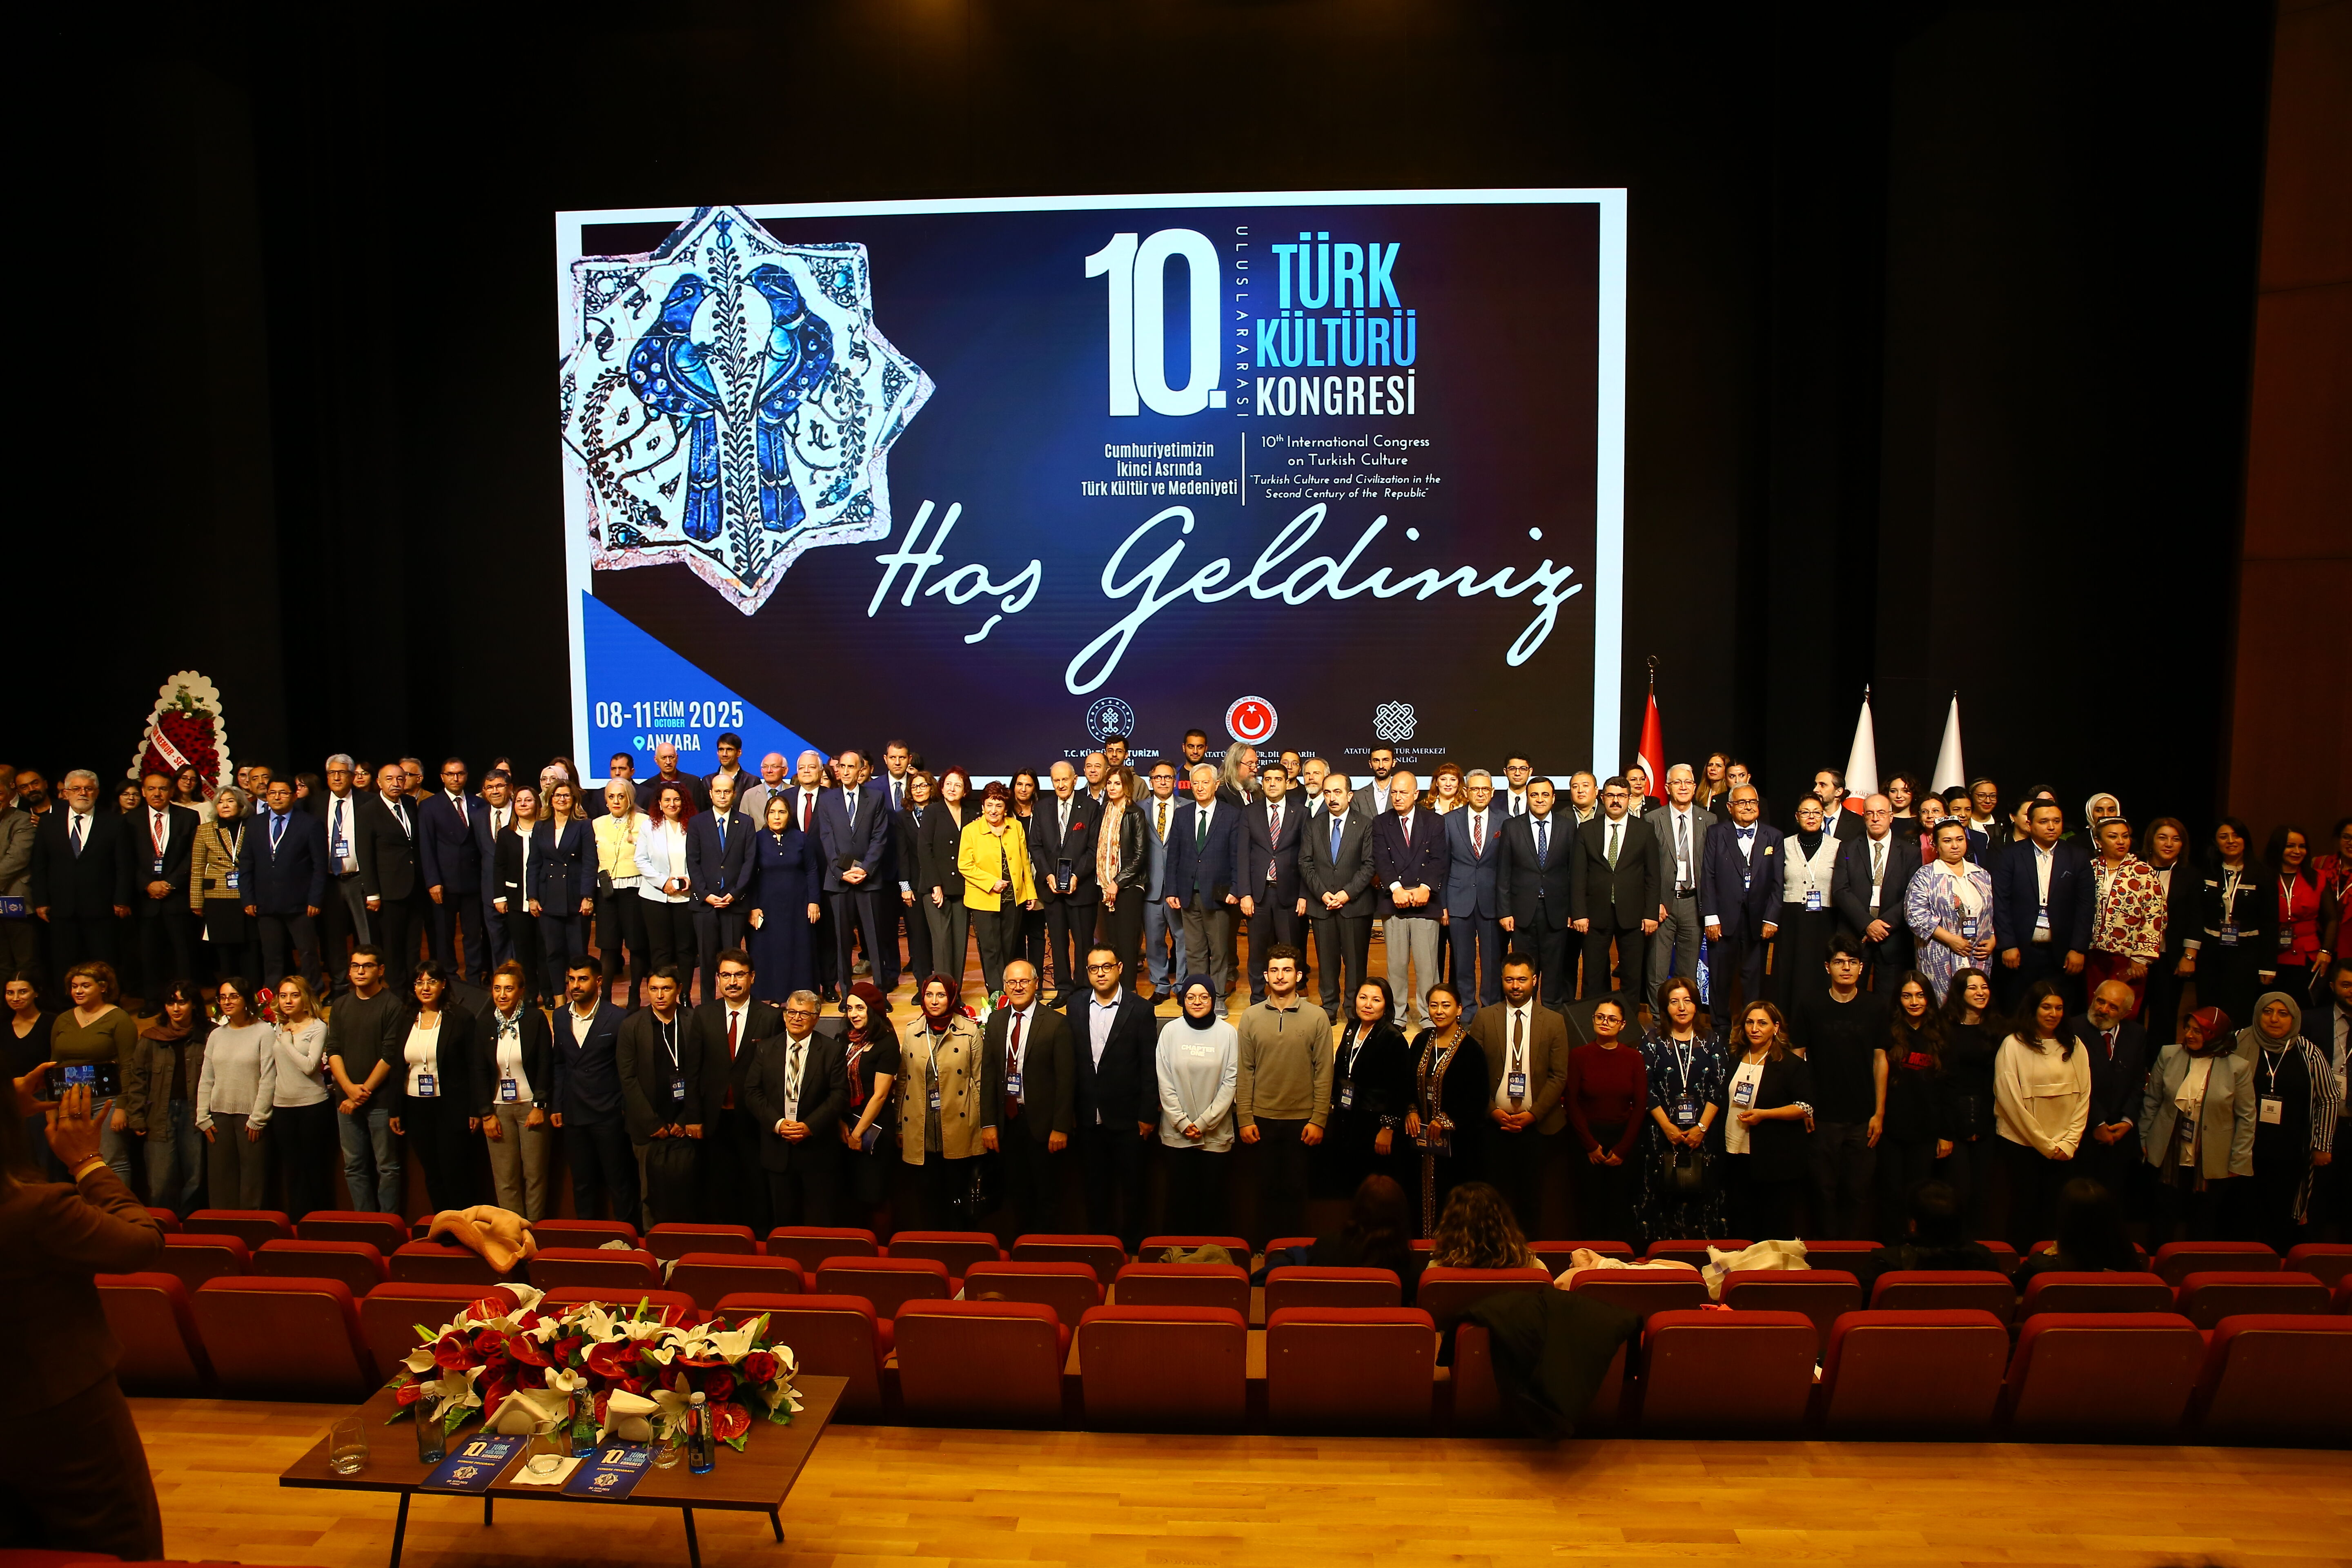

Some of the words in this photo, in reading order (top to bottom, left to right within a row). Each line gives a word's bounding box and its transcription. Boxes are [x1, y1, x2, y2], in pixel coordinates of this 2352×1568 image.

[1272, 231, 1401, 309] TÜRK
[1085, 228, 1227, 416] 10.
[1236, 226, 1250, 417] ULUSLARARASI
[1256, 309, 1417, 367] KÜLTÜRÜ
[1256, 368, 1415, 416] KONGRESİ
[1104, 441, 1214, 459] Cumhuriyetimizin
[1287, 434, 1368, 448] International
[1373, 434, 1430, 450] Congress
[1308, 452, 1356, 466] Turkish
[1361, 452, 1408, 466] Culture
[1117, 460, 1152, 477] İkinci
[1155, 461, 1202, 476] Asrında
[1294, 474, 1330, 484] Culture
[1333, 474, 1352, 484] and
[1356, 473, 1410, 484] Civilization
[1413, 475, 1422, 483] in
[1425, 473, 1441, 483] the
[1081, 481, 1108, 496] Türk
[1111, 480, 1149, 496] Kültür
[1151, 482, 1165, 495] ve
[1168, 479, 1238, 496] Medeniyeti
[1265, 488, 1302, 498] Second
[1305, 488, 1345, 501] Century
[1348, 488, 1360, 498] of
[1362, 487, 1378, 497] the
[866, 499, 1042, 644] Hoş
[1064, 502, 1584, 696] Geldiniz
[595, 701, 652, 728] 08-11
[654, 699, 685, 717] EKİM
[689, 701, 744, 728] 2025
[654, 718, 685, 728] OCTOBER
[156, 734, 174, 756] MEMUR
[174, 756, 186, 766] SE
[1127, 748, 1159, 757] TURİZM
[1181, 1044, 1215, 1053] CHAPTER
